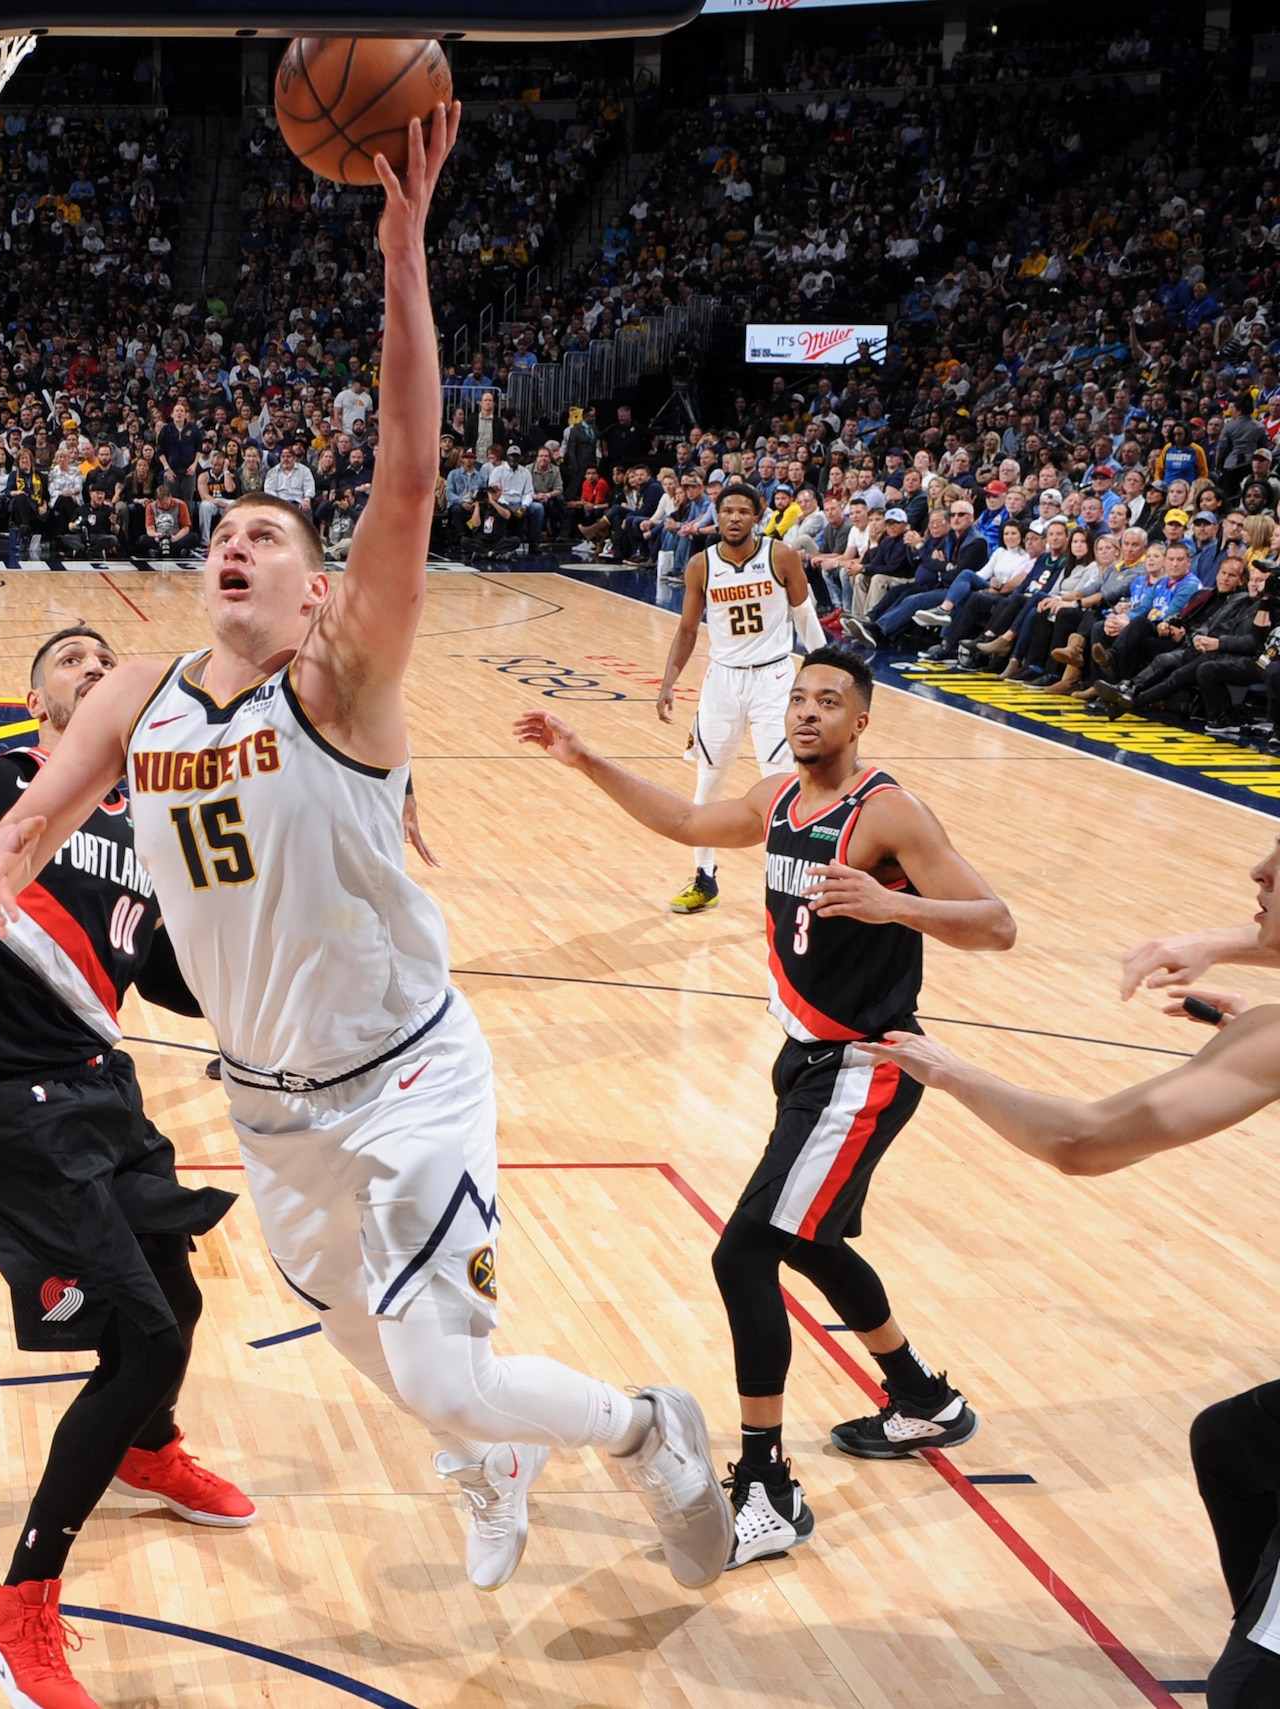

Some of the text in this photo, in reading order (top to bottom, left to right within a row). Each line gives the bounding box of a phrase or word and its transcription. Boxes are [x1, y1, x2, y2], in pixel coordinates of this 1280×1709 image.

[777, 336, 795, 347] IT'S
[797, 328, 855, 361] Miller
[709, 580, 773, 604] NUGGETS
[728, 602, 764, 636] 25
[133, 728, 281, 795] NUGGETS
[54, 830, 154, 898] PORTLAND
[168, 795, 258, 891] 15
[109, 894, 145, 956] 00
[793, 904, 810, 956] 3
